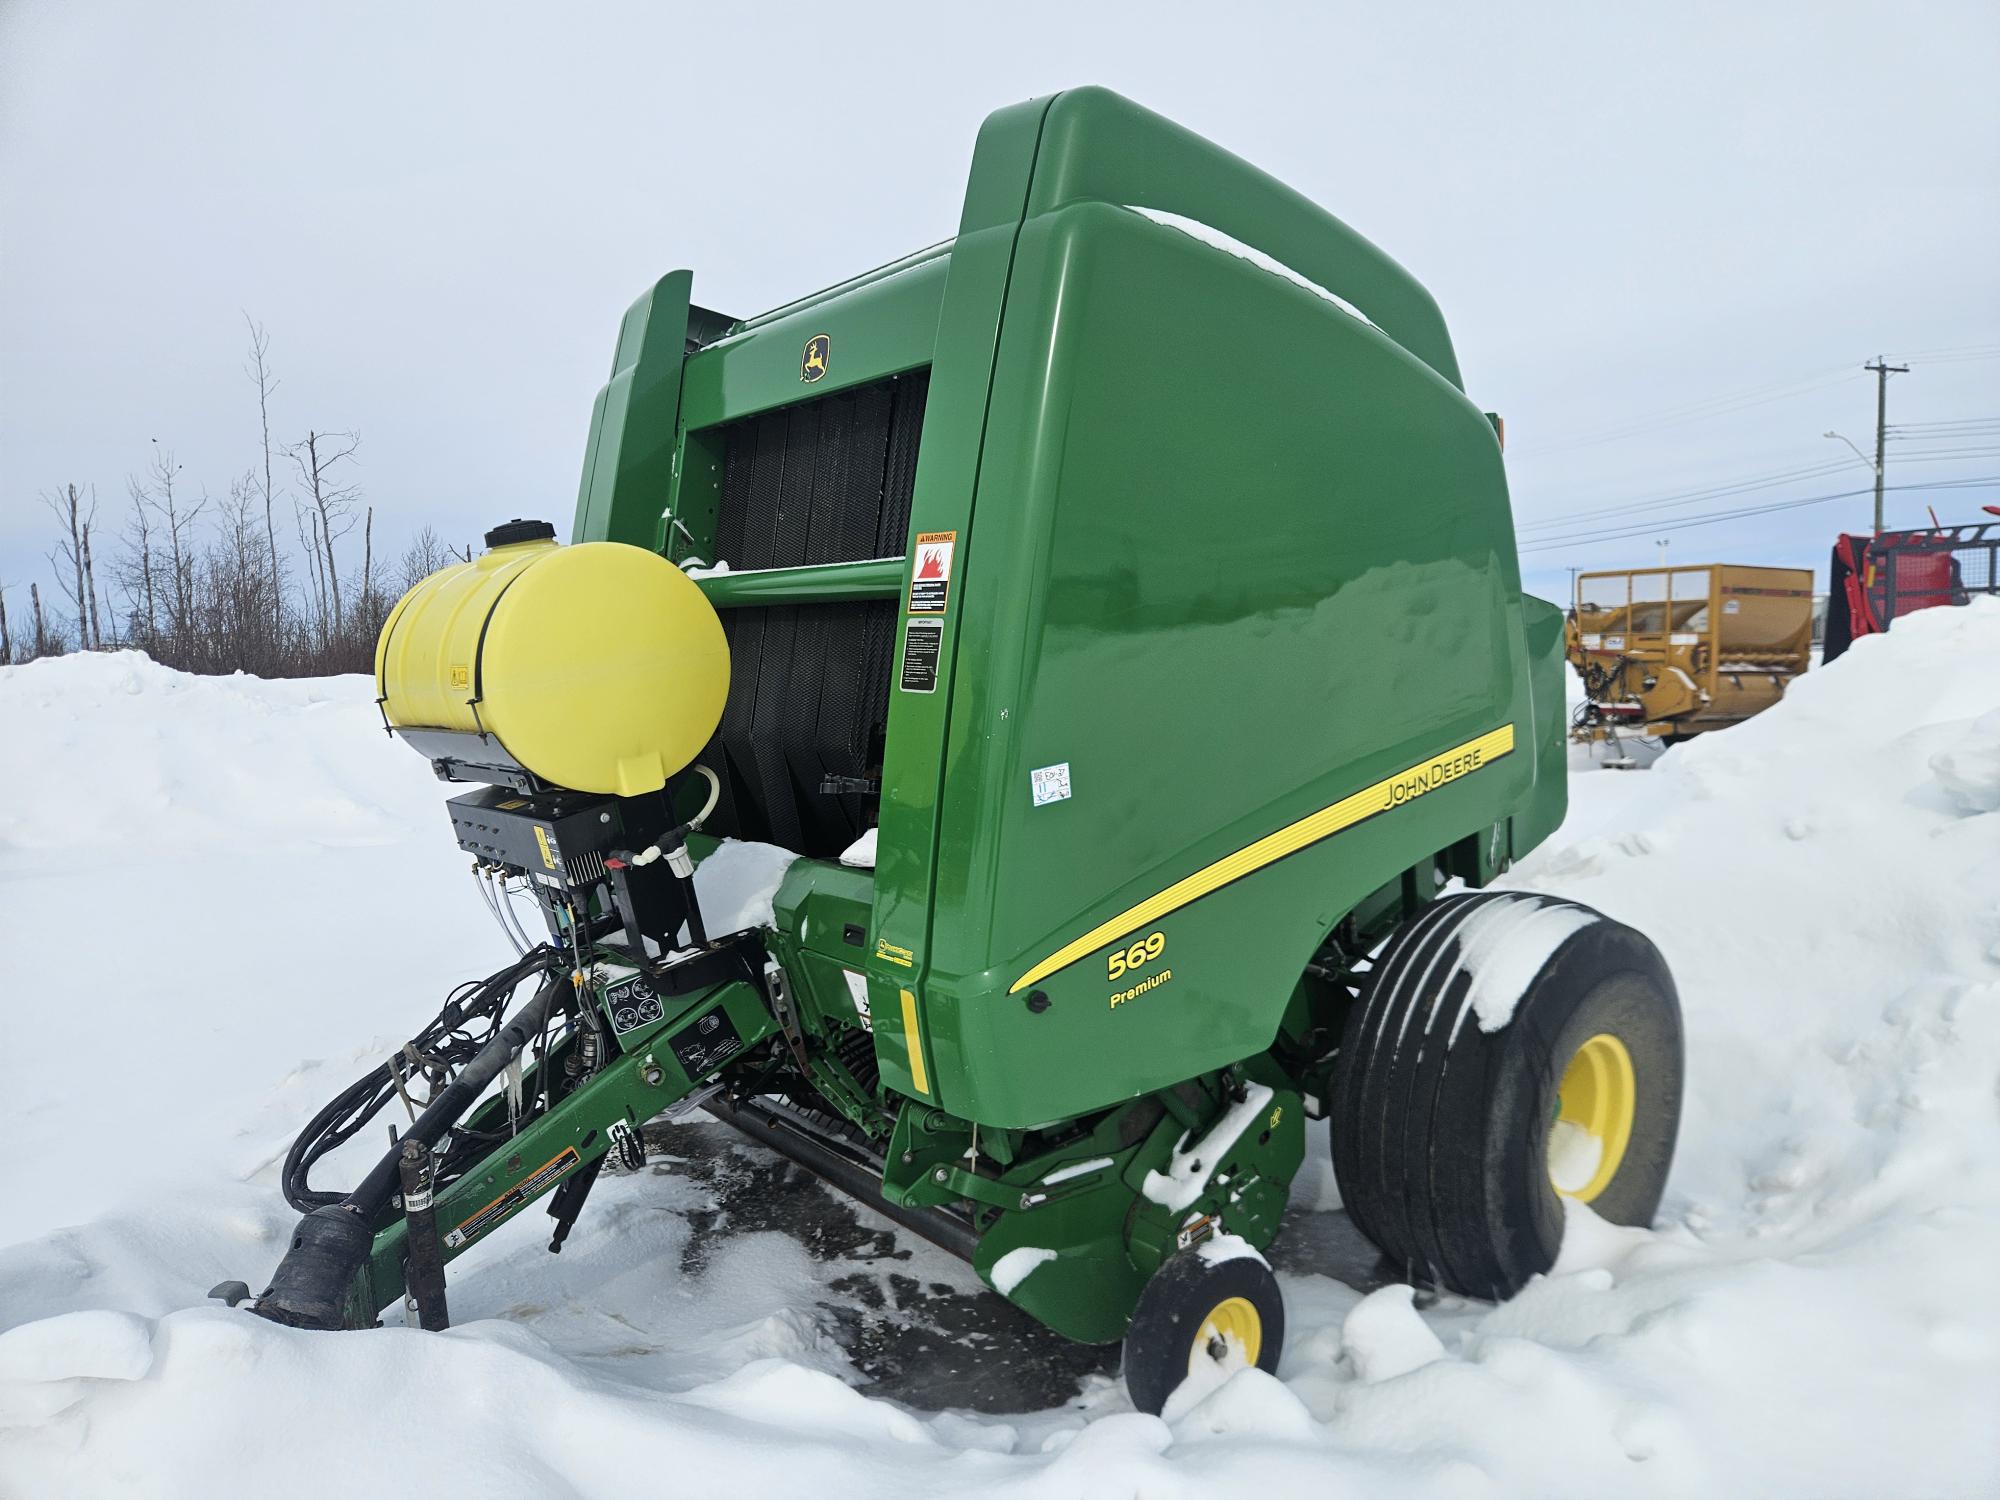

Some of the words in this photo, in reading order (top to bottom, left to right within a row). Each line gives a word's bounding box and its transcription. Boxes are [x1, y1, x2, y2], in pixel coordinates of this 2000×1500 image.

[925, 533, 953, 542] WARNING
[1384, 773, 1428, 807] JOHN
[1431, 748, 1482, 785] DEERE
[1108, 931, 1165, 981] 569
[1110, 969, 1172, 1009] Premium
